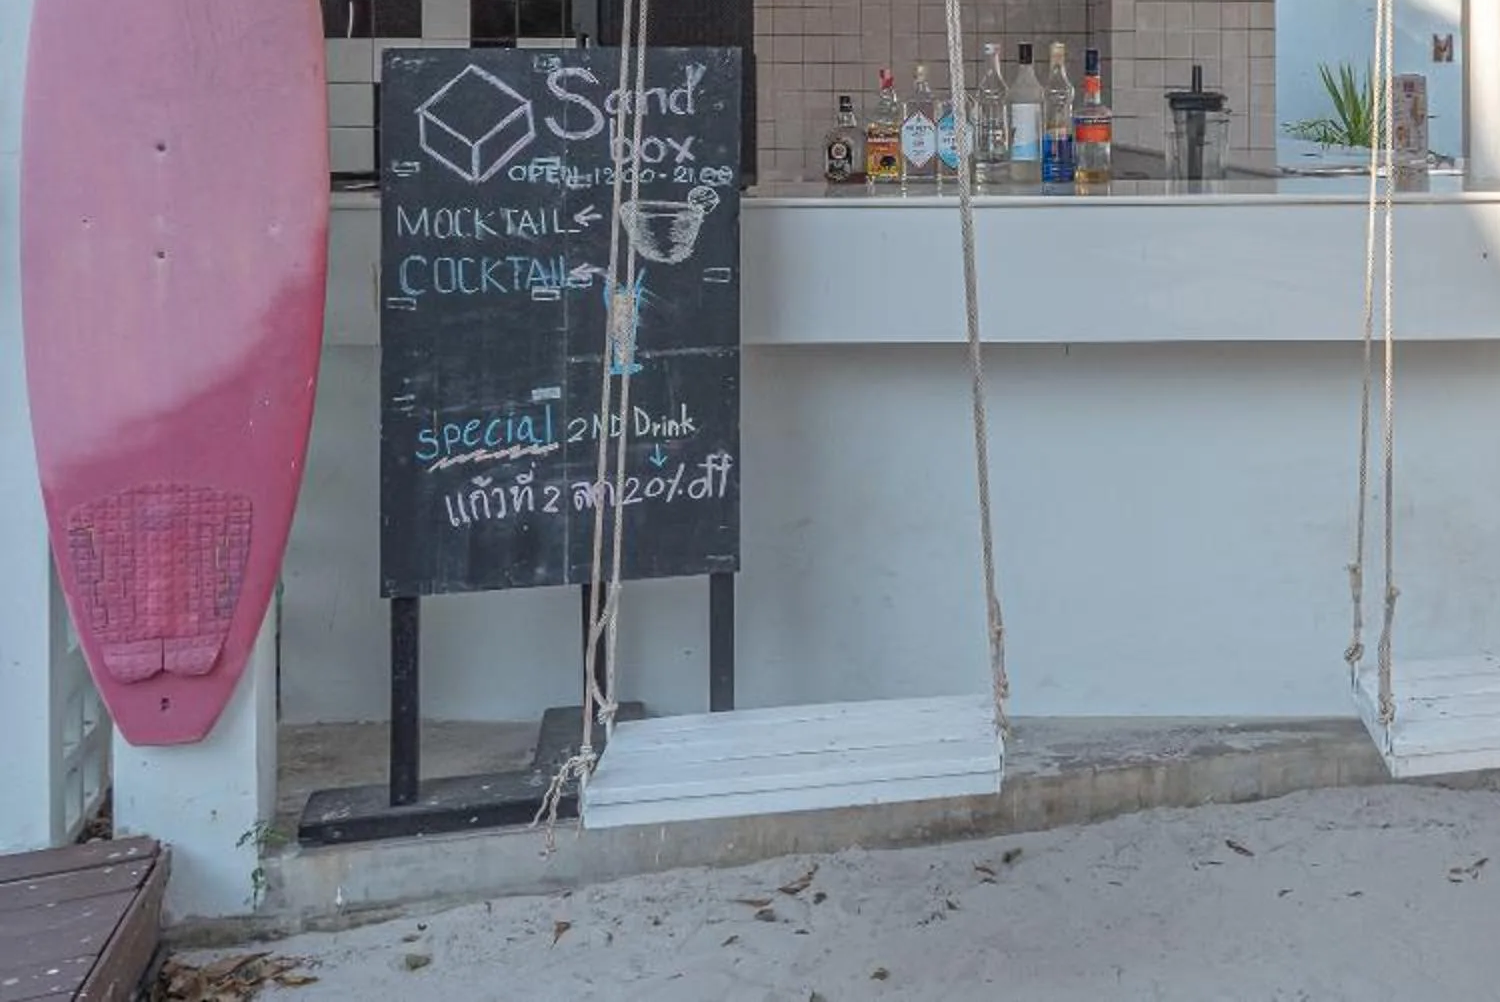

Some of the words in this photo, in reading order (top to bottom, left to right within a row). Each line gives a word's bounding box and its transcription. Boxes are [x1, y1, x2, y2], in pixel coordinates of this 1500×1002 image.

[543, 62, 706, 141] Sand
[396, 205, 581, 239] MOCKTAIL
[400, 254, 580, 295] COCKTAIL
[633, 402, 697, 437] Drink
